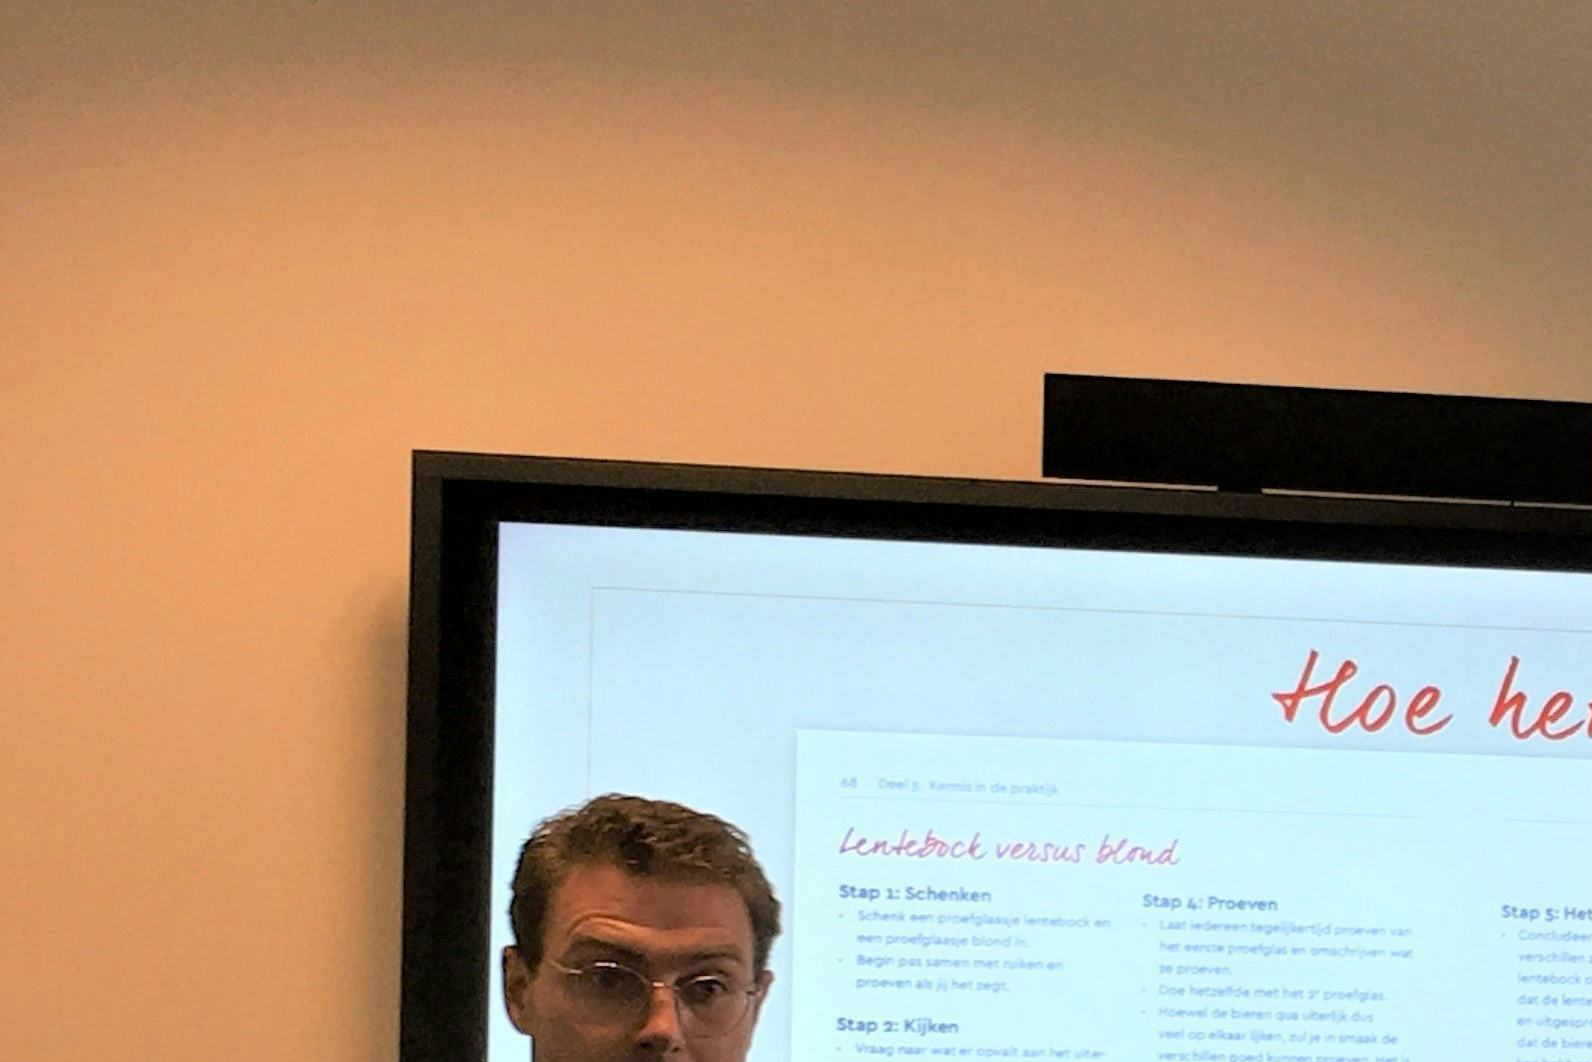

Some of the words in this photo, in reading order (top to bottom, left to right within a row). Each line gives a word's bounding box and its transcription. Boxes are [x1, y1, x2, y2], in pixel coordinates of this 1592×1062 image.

[1272, 648, 1452, 735] Hoe
[878, 778, 908, 790] Deel
[930, 780, 971, 793] Kennis
[975, 781, 986, 793] in
[990, 781, 1007, 794] de
[1010, 782, 1058, 797] praktijk
[839, 827, 987, 859] Lentebock
[996, 841, 1086, 863] versus
[1096, 834, 1180, 865] blond
[839, 884, 880, 901] Stap
[886, 887, 900, 900] 1:
[905, 886, 991, 902] Schenken
[1142, 893, 1182, 910] Stap
[1187, 896, 1203, 911] 4:
[1207, 895, 1278, 911] Proeven
[1502, 904, 1540, 921] Stap
[1545, 907, 1559, 922] 5:
[1095, 918, 1110, 928] en
[1291, 945, 1304, 956] en
[1047, 960, 1062, 970] en
[1159, 964, 1173, 974] ze
[1542, 993, 1558, 1006] de
[836, 1017, 878, 1034] Stap
[883, 1020, 899, 1033] 2:
[904, 1019, 959, 1036] Kijken
